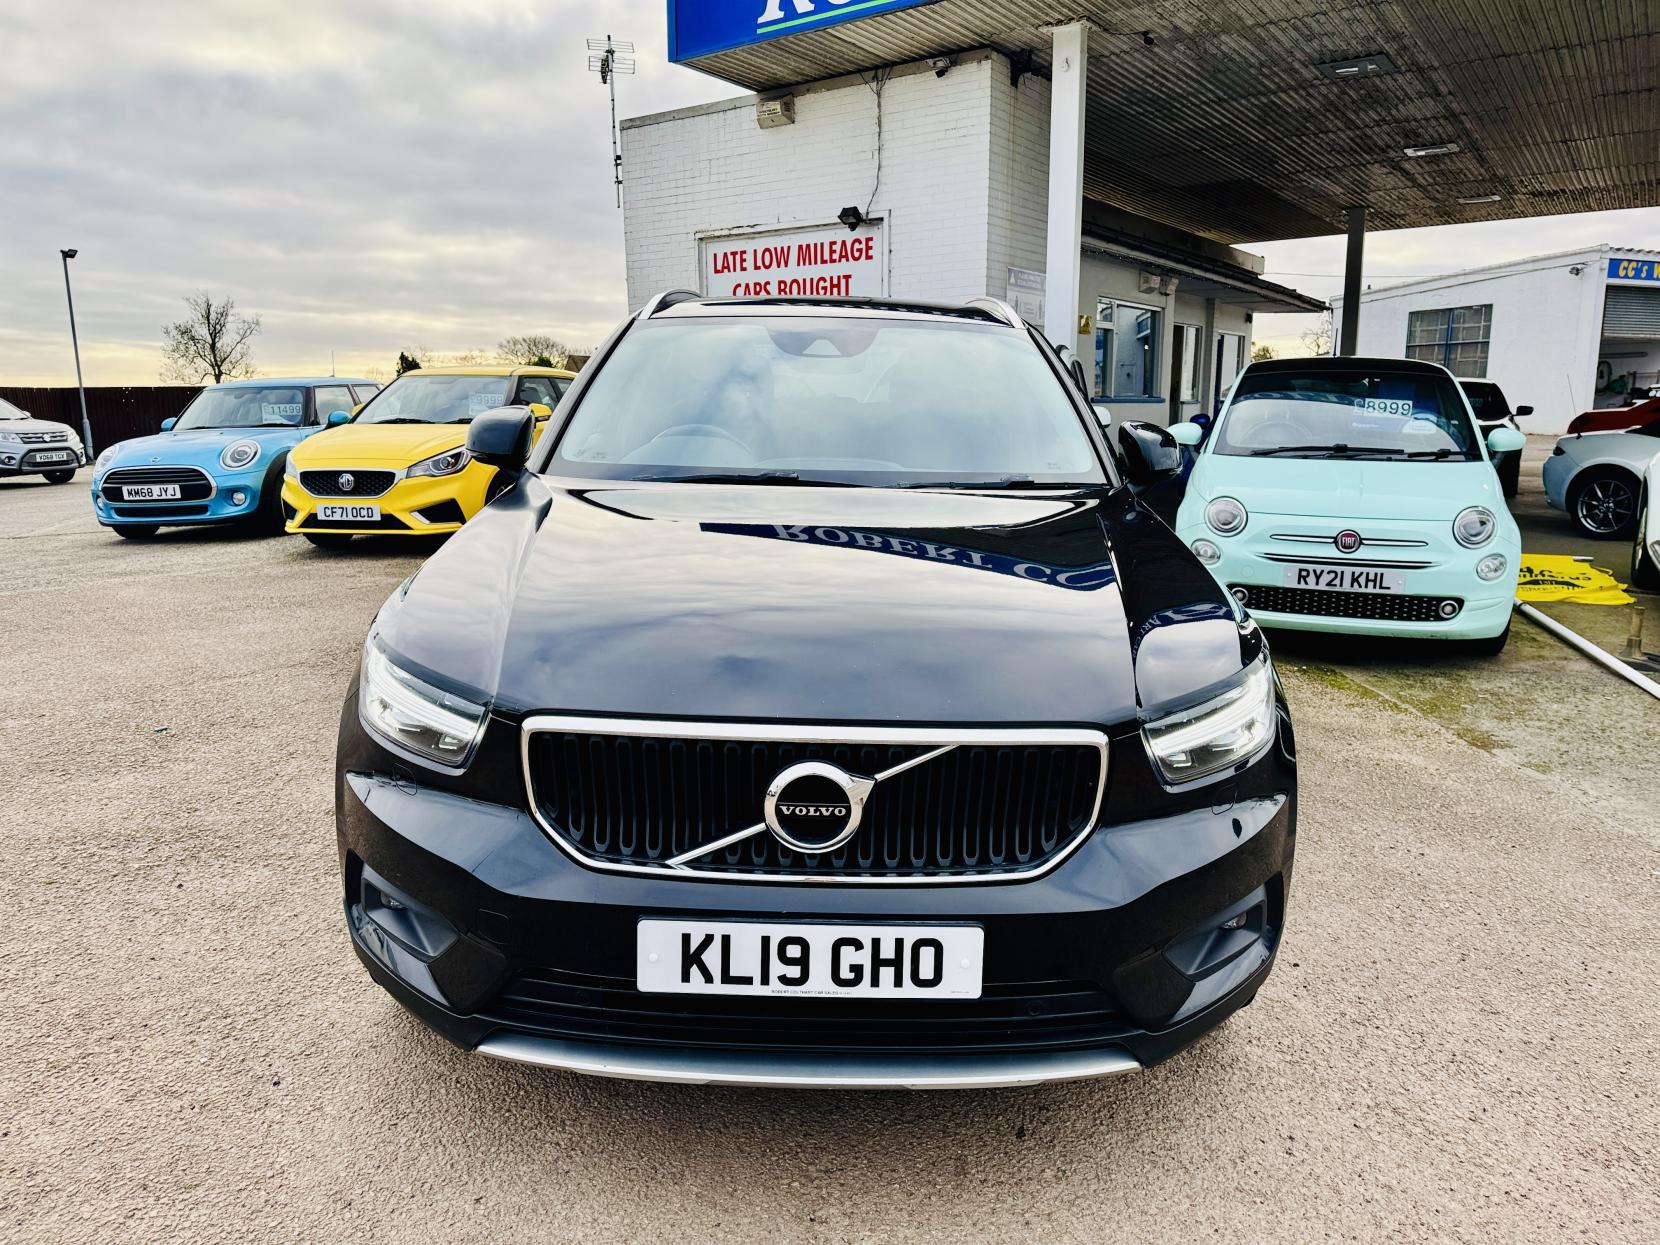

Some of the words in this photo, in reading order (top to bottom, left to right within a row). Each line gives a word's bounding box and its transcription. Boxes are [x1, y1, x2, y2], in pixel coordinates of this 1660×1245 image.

[713, 250, 748, 274] LATE
[753, 245, 791, 271] LOW
[797, 236, 874, 267] MILEAGE
[156, 486, 177, 497] JYJ
[323, 506, 349, 518] CF71
[351, 506, 374, 519] OCD
[1341, 537, 1356, 548] FIAT
[1296, 568, 1345, 587] RY21
[1350, 571, 1391, 590] KHL
[779, 805, 847, 816] VOLVO
[680, 932, 811, 987] KL19
[830, 936, 944, 989] GHO
